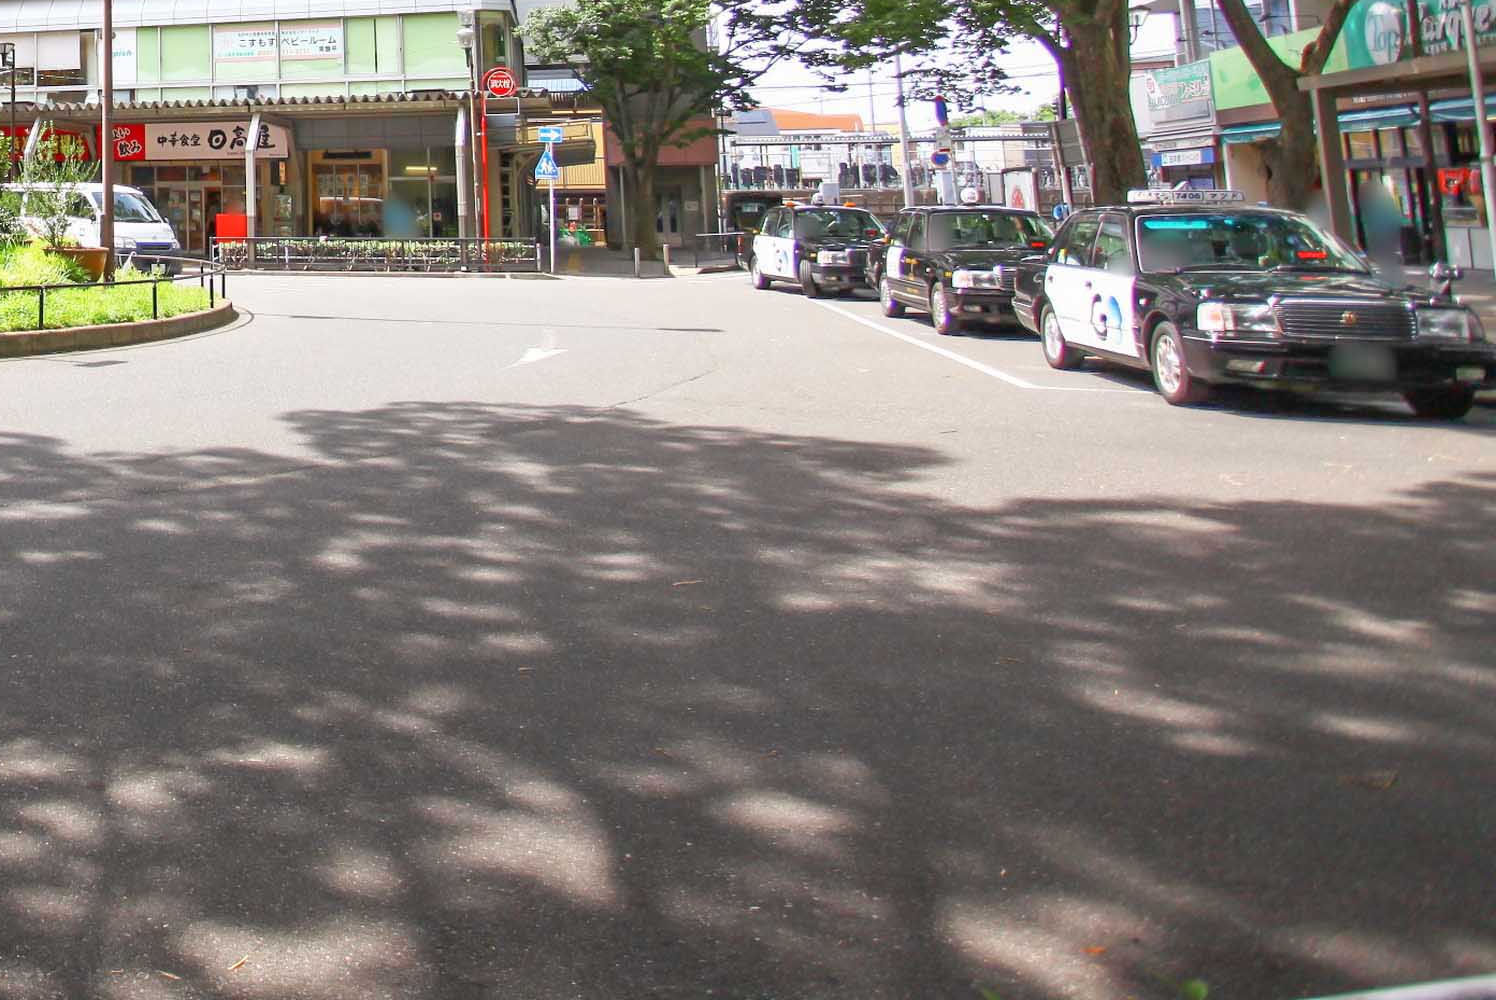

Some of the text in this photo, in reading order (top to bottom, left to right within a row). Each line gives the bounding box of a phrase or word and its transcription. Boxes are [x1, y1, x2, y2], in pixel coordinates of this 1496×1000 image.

[239, 38, 276, 48] こすもす
[157, 125, 276, 150] 中華食堂 日高屋
